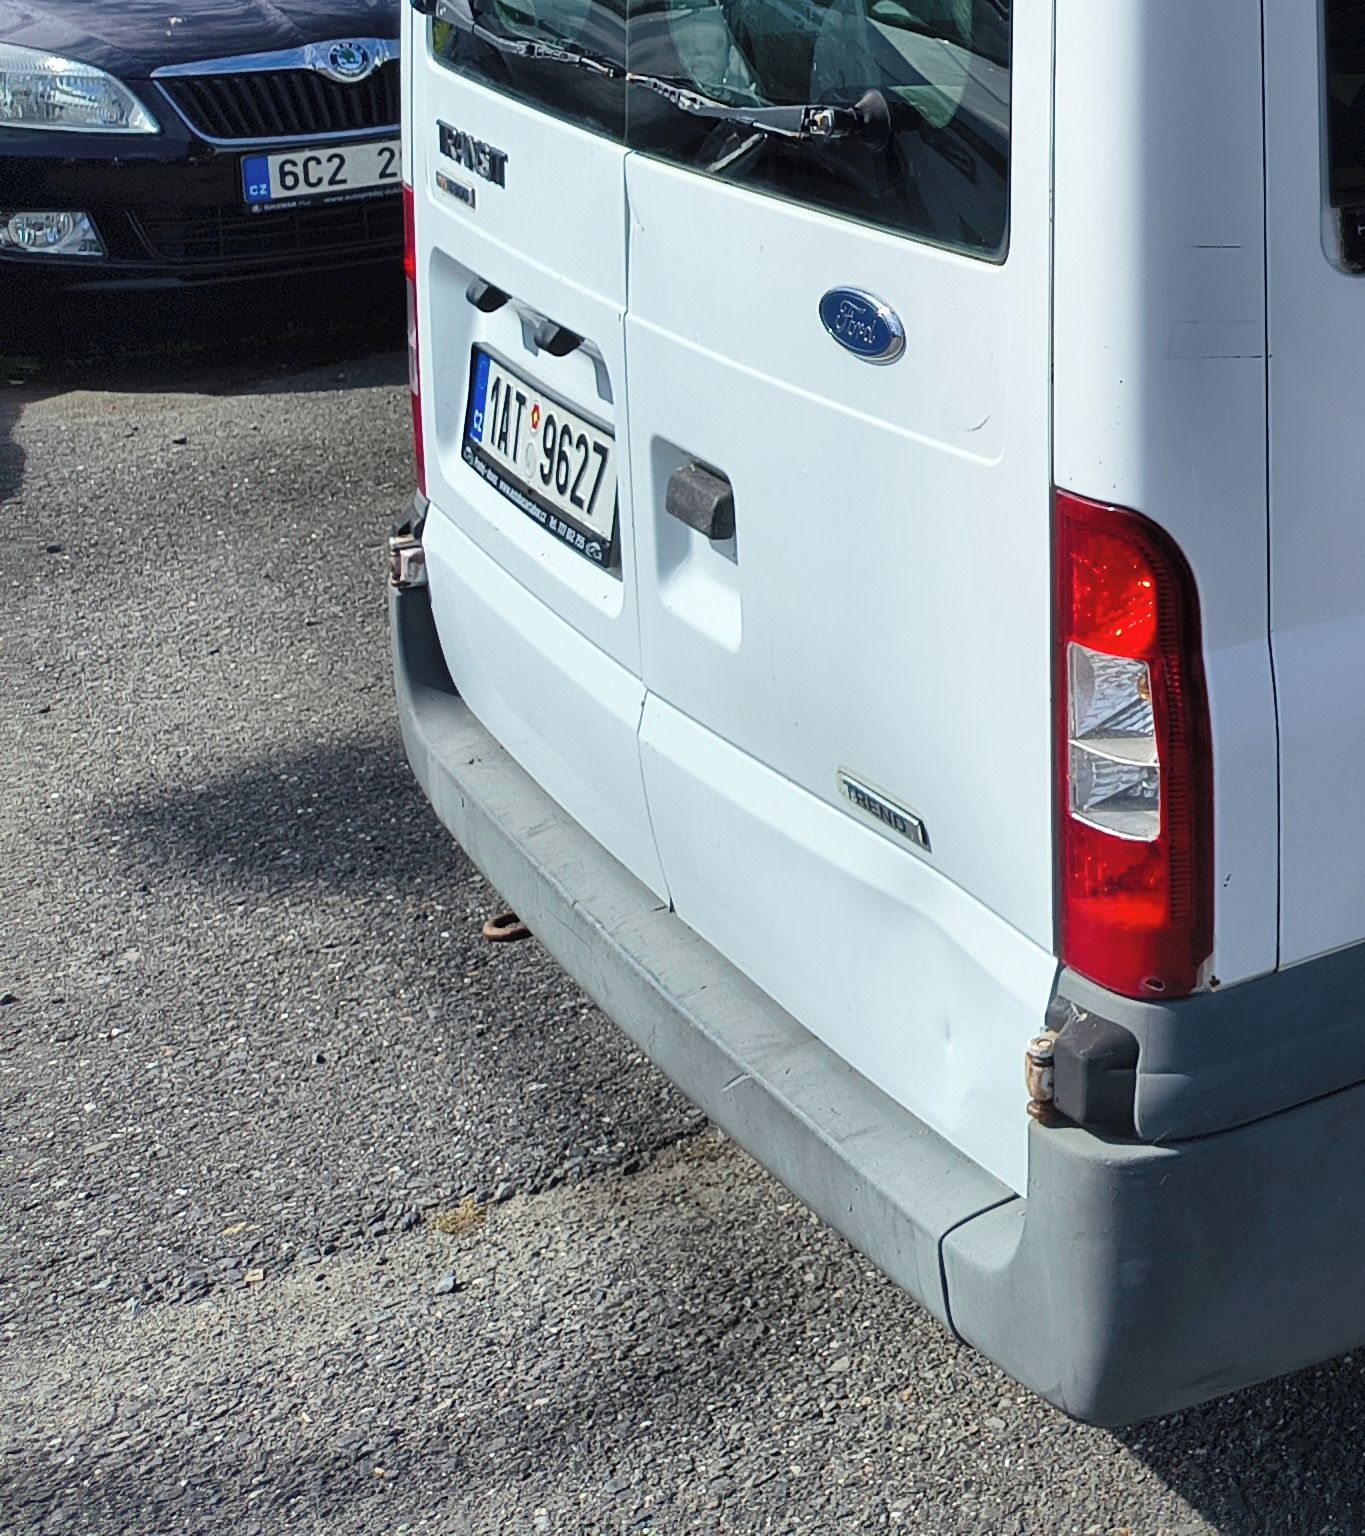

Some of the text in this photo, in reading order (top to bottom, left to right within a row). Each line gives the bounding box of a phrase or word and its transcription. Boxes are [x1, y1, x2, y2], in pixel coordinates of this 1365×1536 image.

[249, 184, 267, 196] CZ
[278, 146, 402, 191] 6C2 2
[835, 300, 876, 344] Ford
[489, 375, 528, 465] 1AT
[539, 413, 608, 517] 9627
[843, 779, 906, 834] TREND
